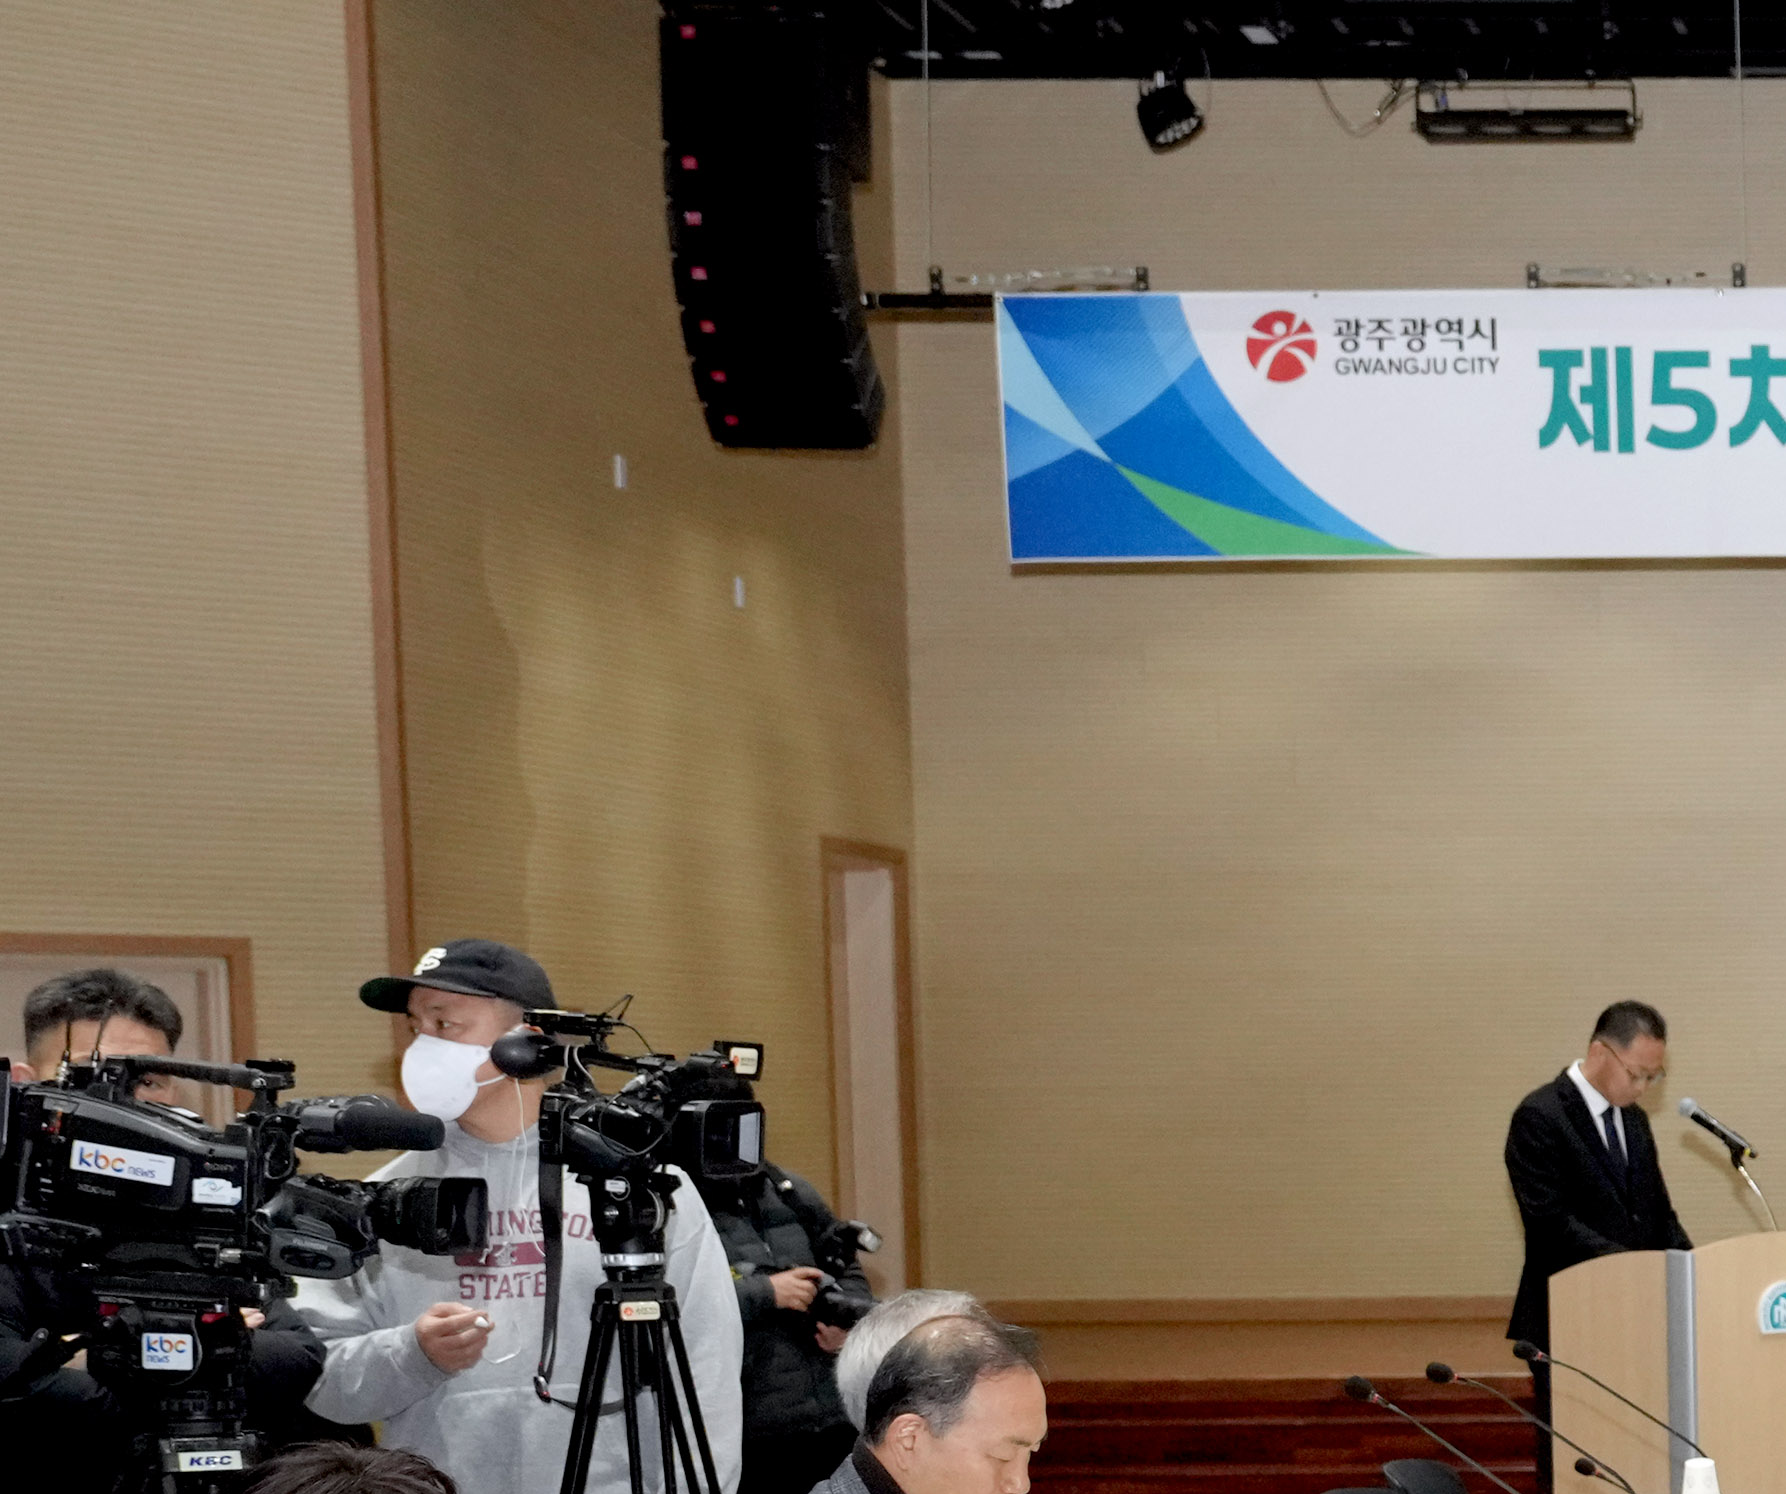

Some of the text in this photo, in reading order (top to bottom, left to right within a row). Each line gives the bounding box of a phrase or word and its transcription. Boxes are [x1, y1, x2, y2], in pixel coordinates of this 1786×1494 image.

[1333, 317, 1498, 353] 광주광역시
[1334, 357, 1500, 375] GWANGJU CITY
[78, 1147, 126, 1173] kbc
[146, 1335, 187, 1354] kbc
